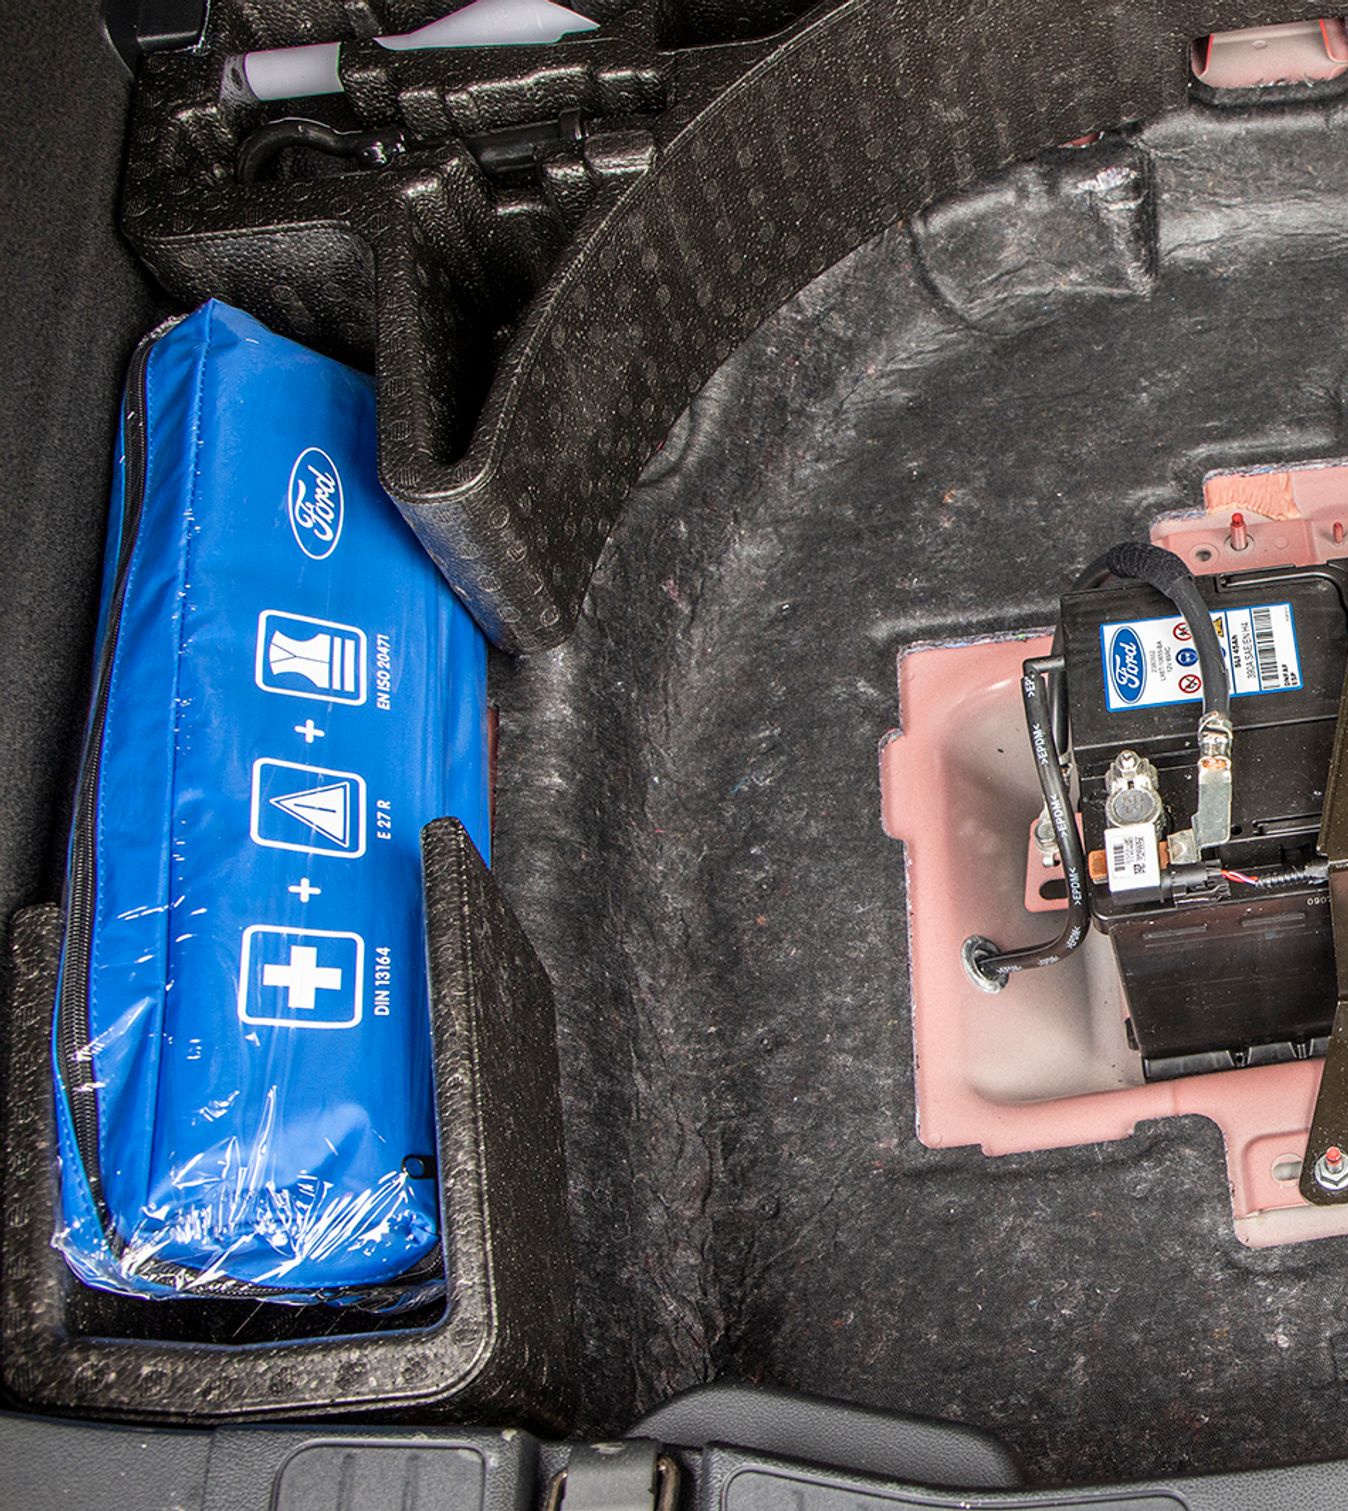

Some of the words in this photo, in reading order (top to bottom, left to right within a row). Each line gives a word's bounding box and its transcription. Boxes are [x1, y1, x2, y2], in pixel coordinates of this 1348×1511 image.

[294, 464, 335, 542] Ford
[376, 634, 391, 666] 20471
[377, 667, 391, 690] ISO
[1115, 641, 1140, 689] Ford
[377, 690, 391, 710] EN
[1024, 675, 1035, 698] >EP
[1032, 723, 1049, 767] >EPDM<
[377, 799, 391, 810] R
[1050, 793, 1069, 838] >EPDM<
[377, 810, 391, 829] 27
[377, 831, 391, 840] E
[1069, 866, 1082, 906] >EPDM<
[375, 946, 391, 987] 13164
[374, 990, 390, 1016] DIN
